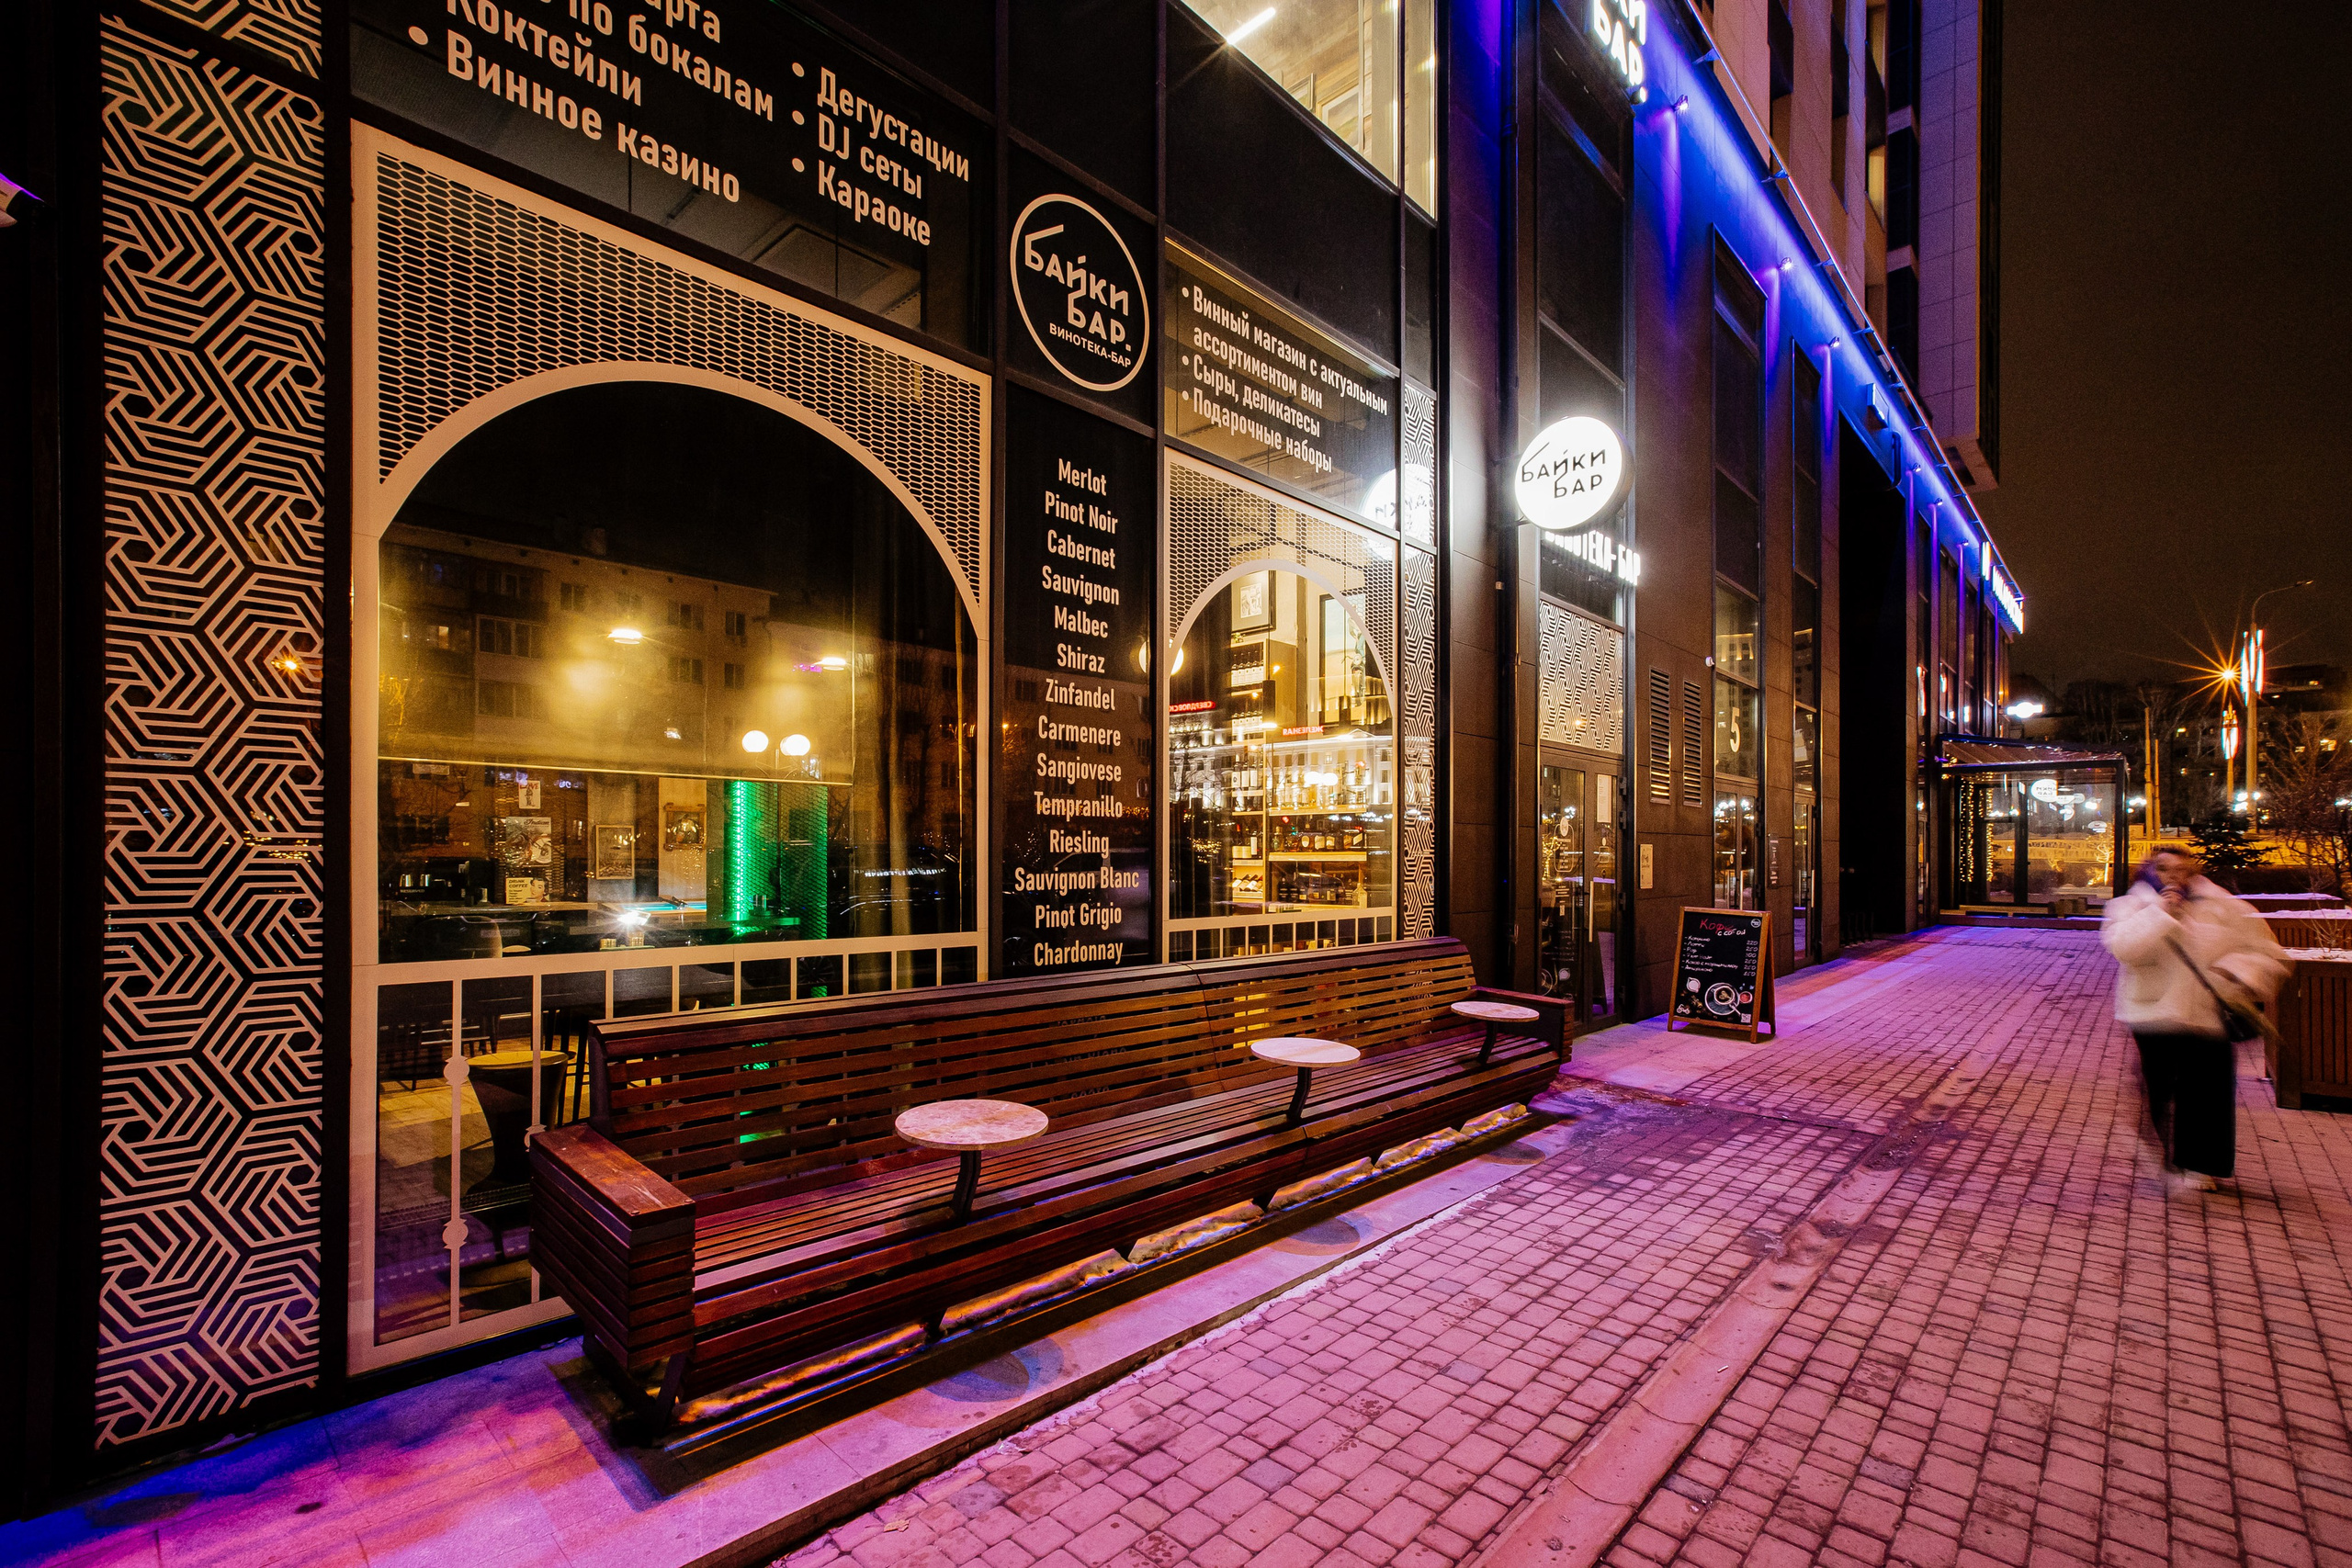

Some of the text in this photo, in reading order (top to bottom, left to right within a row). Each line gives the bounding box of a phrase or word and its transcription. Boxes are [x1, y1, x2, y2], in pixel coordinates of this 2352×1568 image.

[628, 14, 773, 121] бокалам
[447, 28, 740, 202] Винное казино
[817, 67, 969, 182] Дегустации
[818, 113, 922, 199] DJ сеты
[818, 160, 932, 246] Караоке
[1024, 224, 1129, 316] БАЙКИ
[1049, 323, 1131, 368] ВИНОТЕКА-БАР
[1193, 286, 1388, 416] Винный магазин с актуальным
[1193, 327, 1323, 409] ассортиментом вин
[1193, 355, 1320, 438] Сыры, деликатесы
[1193, 388, 1332, 473] Подарочные наборы
[1058, 458, 1106, 496] Merlot
[1521, 442, 1606, 482] БАЙКИ
[1554, 471, 1603, 499] БАР
[1045, 491, 1118, 535] Pinot Noir
[1047, 529, 1115, 570] Cabernet
[1042, 565, 1119, 605] Sauvignon
[1054, 605, 1108, 638] Malbec
[1057, 643, 1105, 673] Shiraz
[1046, 678, 1115, 711] Zinfandel
[1038, 715, 1121, 747] Carmenere
[1730, 706, 1741, 753] 5
[1036, 752, 1122, 784] Sangiovese
[1034, 791, 1123, 822] Tempranillo
[1049, 829, 1110, 859] Riesling
[1014, 866, 1139, 897] Sauvignon Blanc
[1035, 902, 1122, 931] Pinot Grigio
[1034, 940, 1124, 966] Chardonnay
